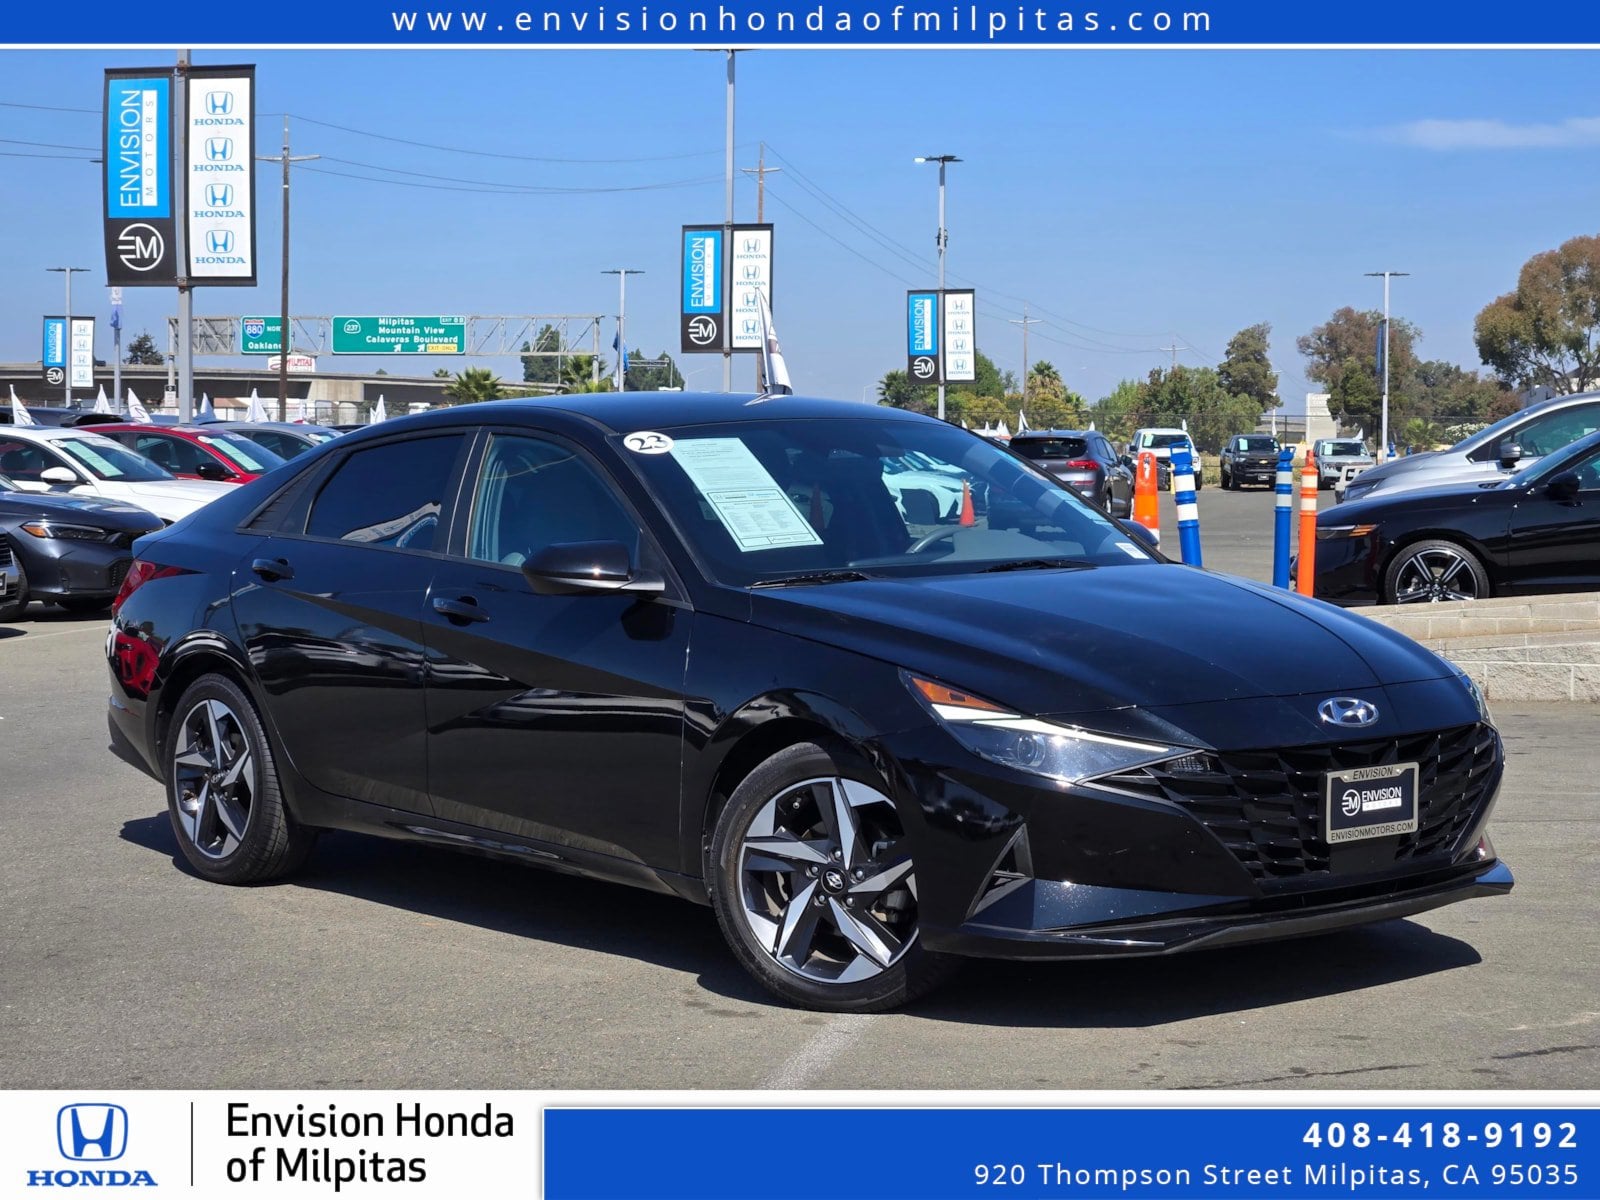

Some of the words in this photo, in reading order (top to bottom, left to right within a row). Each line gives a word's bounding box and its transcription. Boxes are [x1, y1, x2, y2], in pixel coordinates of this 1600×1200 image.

[120, 90, 141, 206] ENVISION
[146, 101, 154, 196] MOTORS
[691, 238, 704, 307] ENVISION
[246, 325, 263, 334] 880
[378, 318, 415, 326] Milpitas
[914, 299, 924, 350] ENVISION
[48, 322, 57, 362] ENVISION
[630, 435, 669, 451] 23
[1352, 768, 1392, 780] ENVISION
[1362, 786, 1402, 801] ENVISION
[1331, 822, 1414, 842] ENVISIONMOTORS.COM
